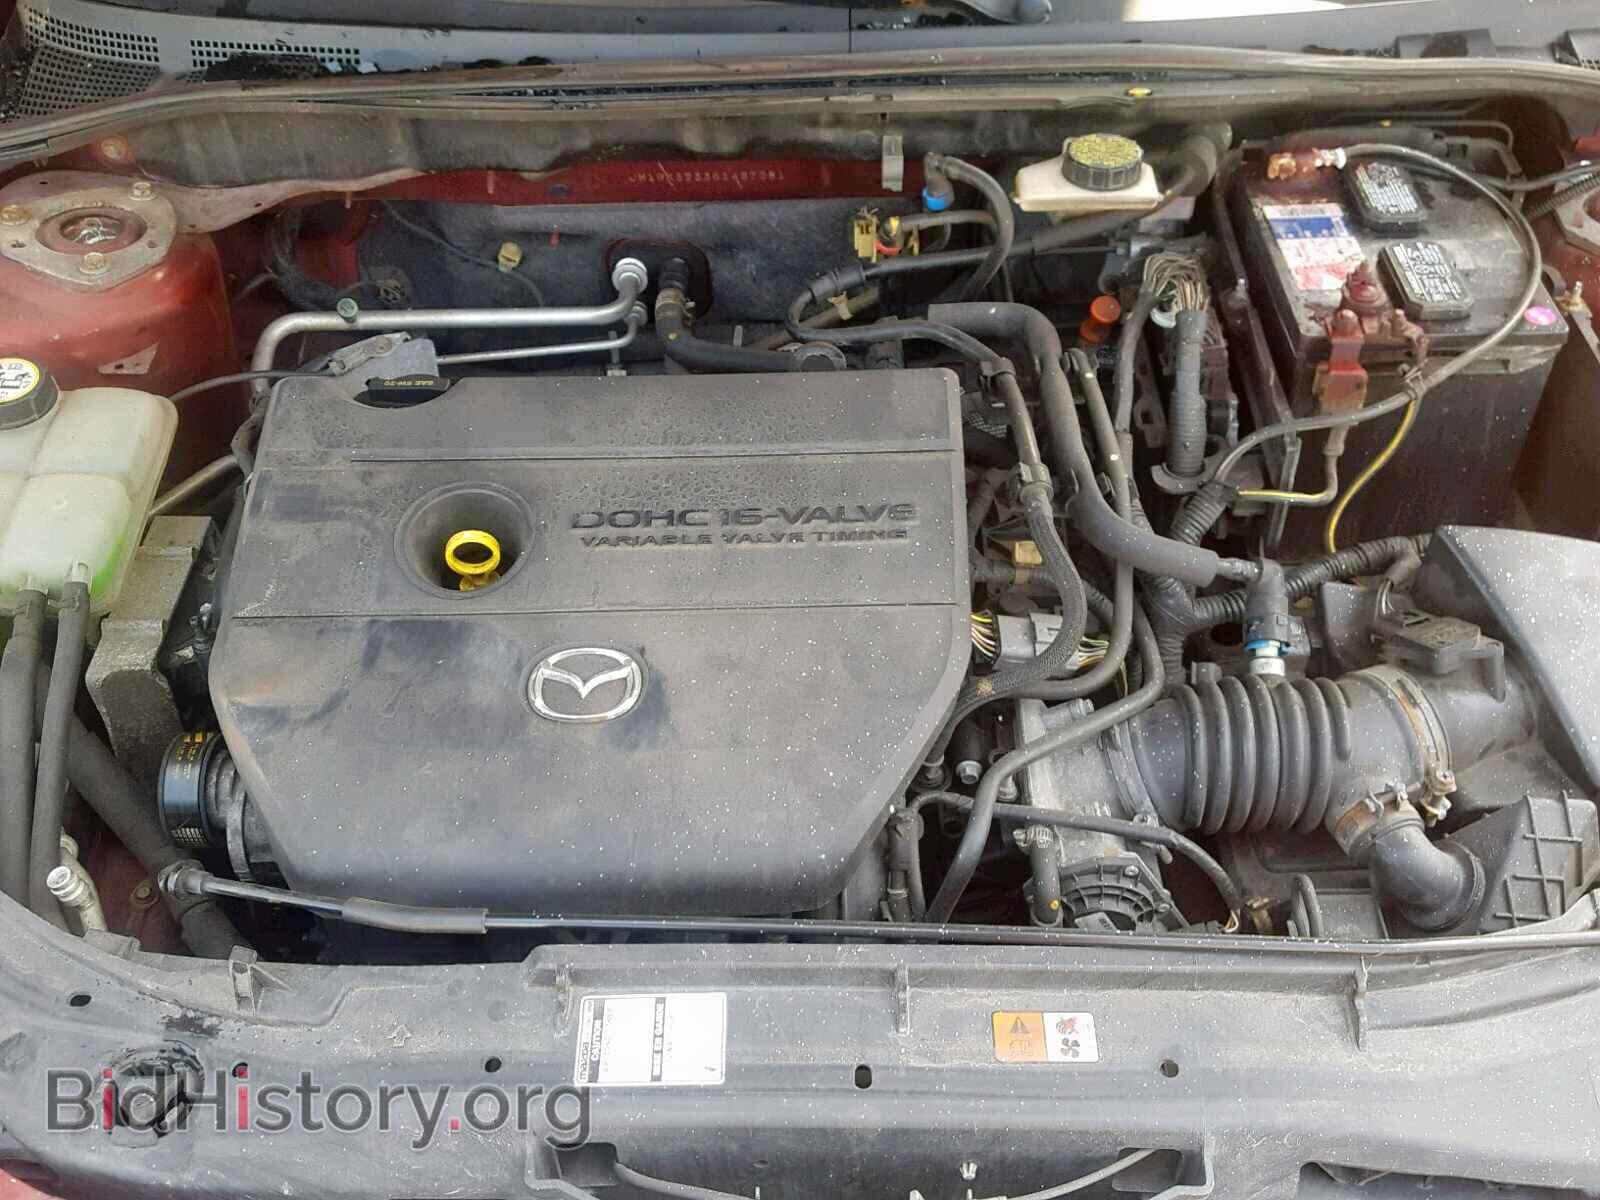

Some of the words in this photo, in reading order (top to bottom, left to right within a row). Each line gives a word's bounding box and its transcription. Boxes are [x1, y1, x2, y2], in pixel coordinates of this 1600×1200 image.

[571, 508, 711, 529] DOHC
[719, 503, 917, 526] 16-VALVE
[580, 534, 713, 546] VARIABLE
[721, 531, 806, 545] VALVE
[811, 529, 908, 543] TIMING
